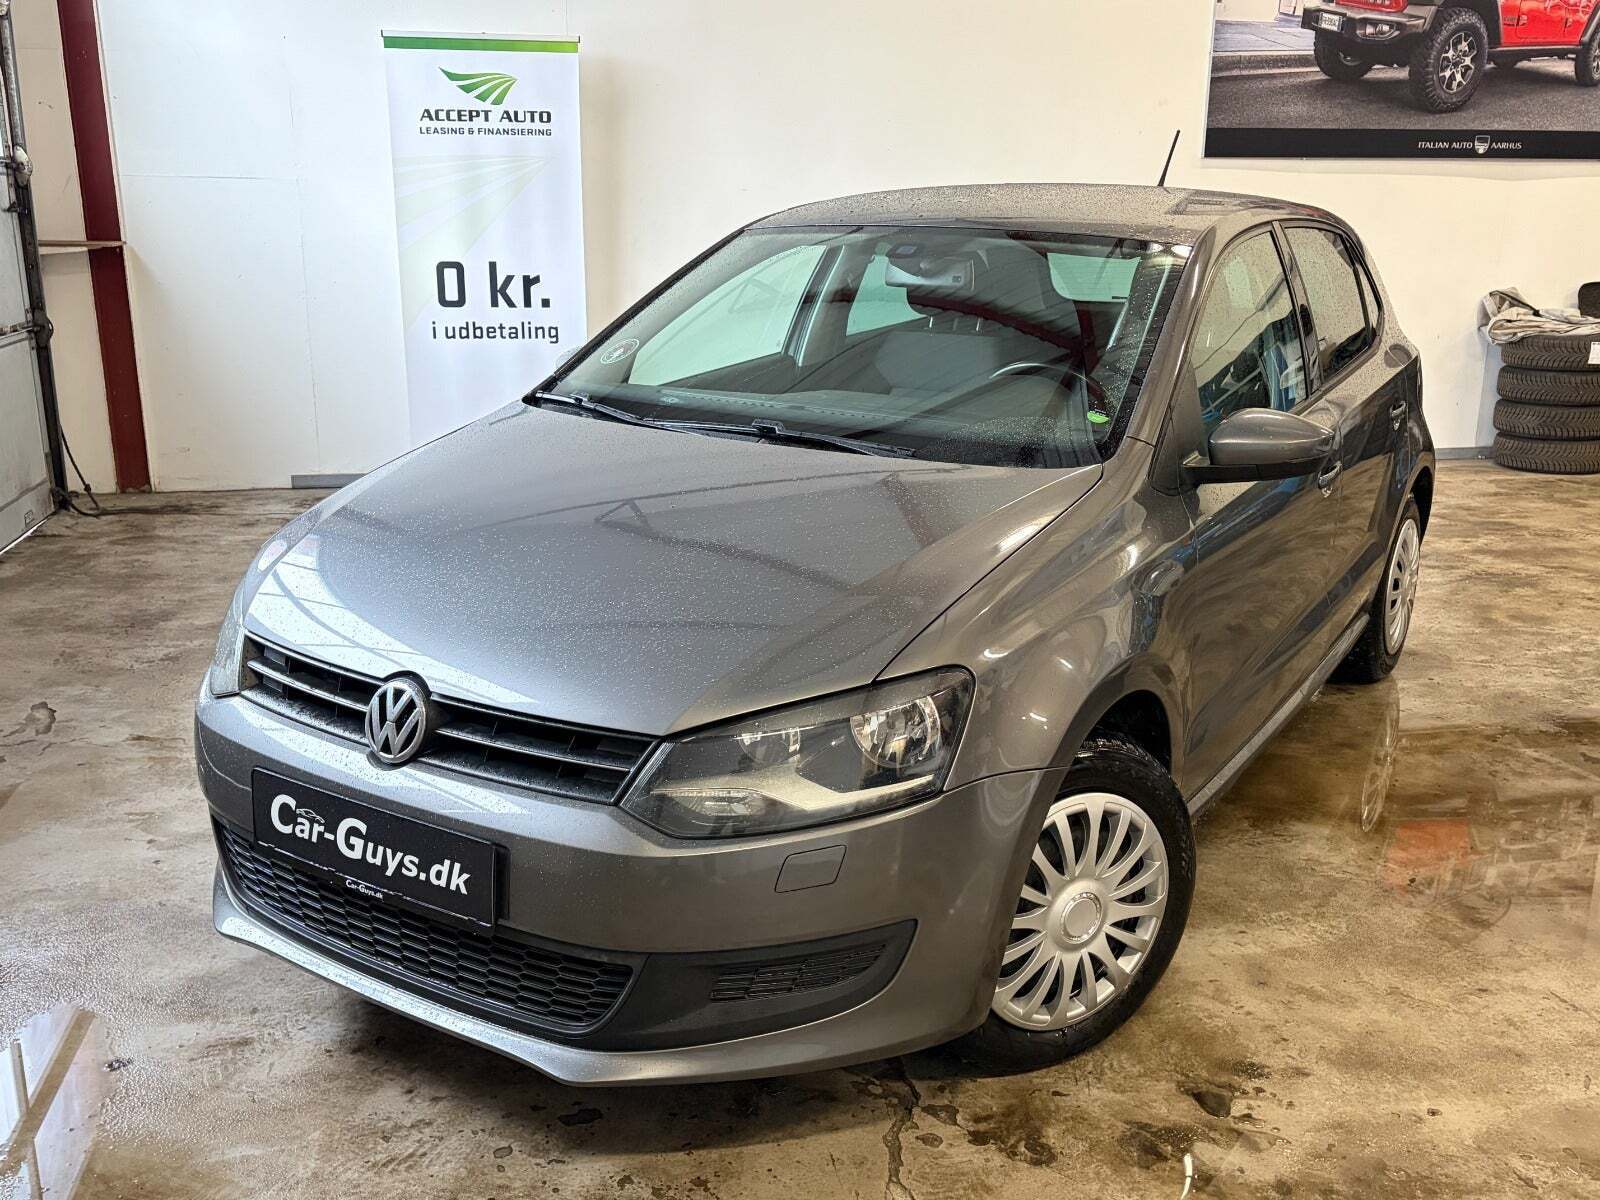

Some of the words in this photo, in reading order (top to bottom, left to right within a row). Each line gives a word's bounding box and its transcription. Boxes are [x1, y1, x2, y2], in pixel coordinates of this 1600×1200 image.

[419, 108, 492, 122] ACCEPT
[499, 109, 552, 123] AUTO
[419, 126, 465, 135] LEASING
[467, 127, 475, 135] &
[477, 127, 552, 136] FINANSIERING
[1418, 141, 1449, 149] ITALIAN
[1451, 141, 1473, 149] AUTO
[488, 261, 551, 308] kr.
[432, 320, 437, 339] i
[444, 320, 559, 344] udbetaling
[270, 793, 471, 895] Car-Guys.dk
[345, 879, 384, 899] Car-Guys.dk
